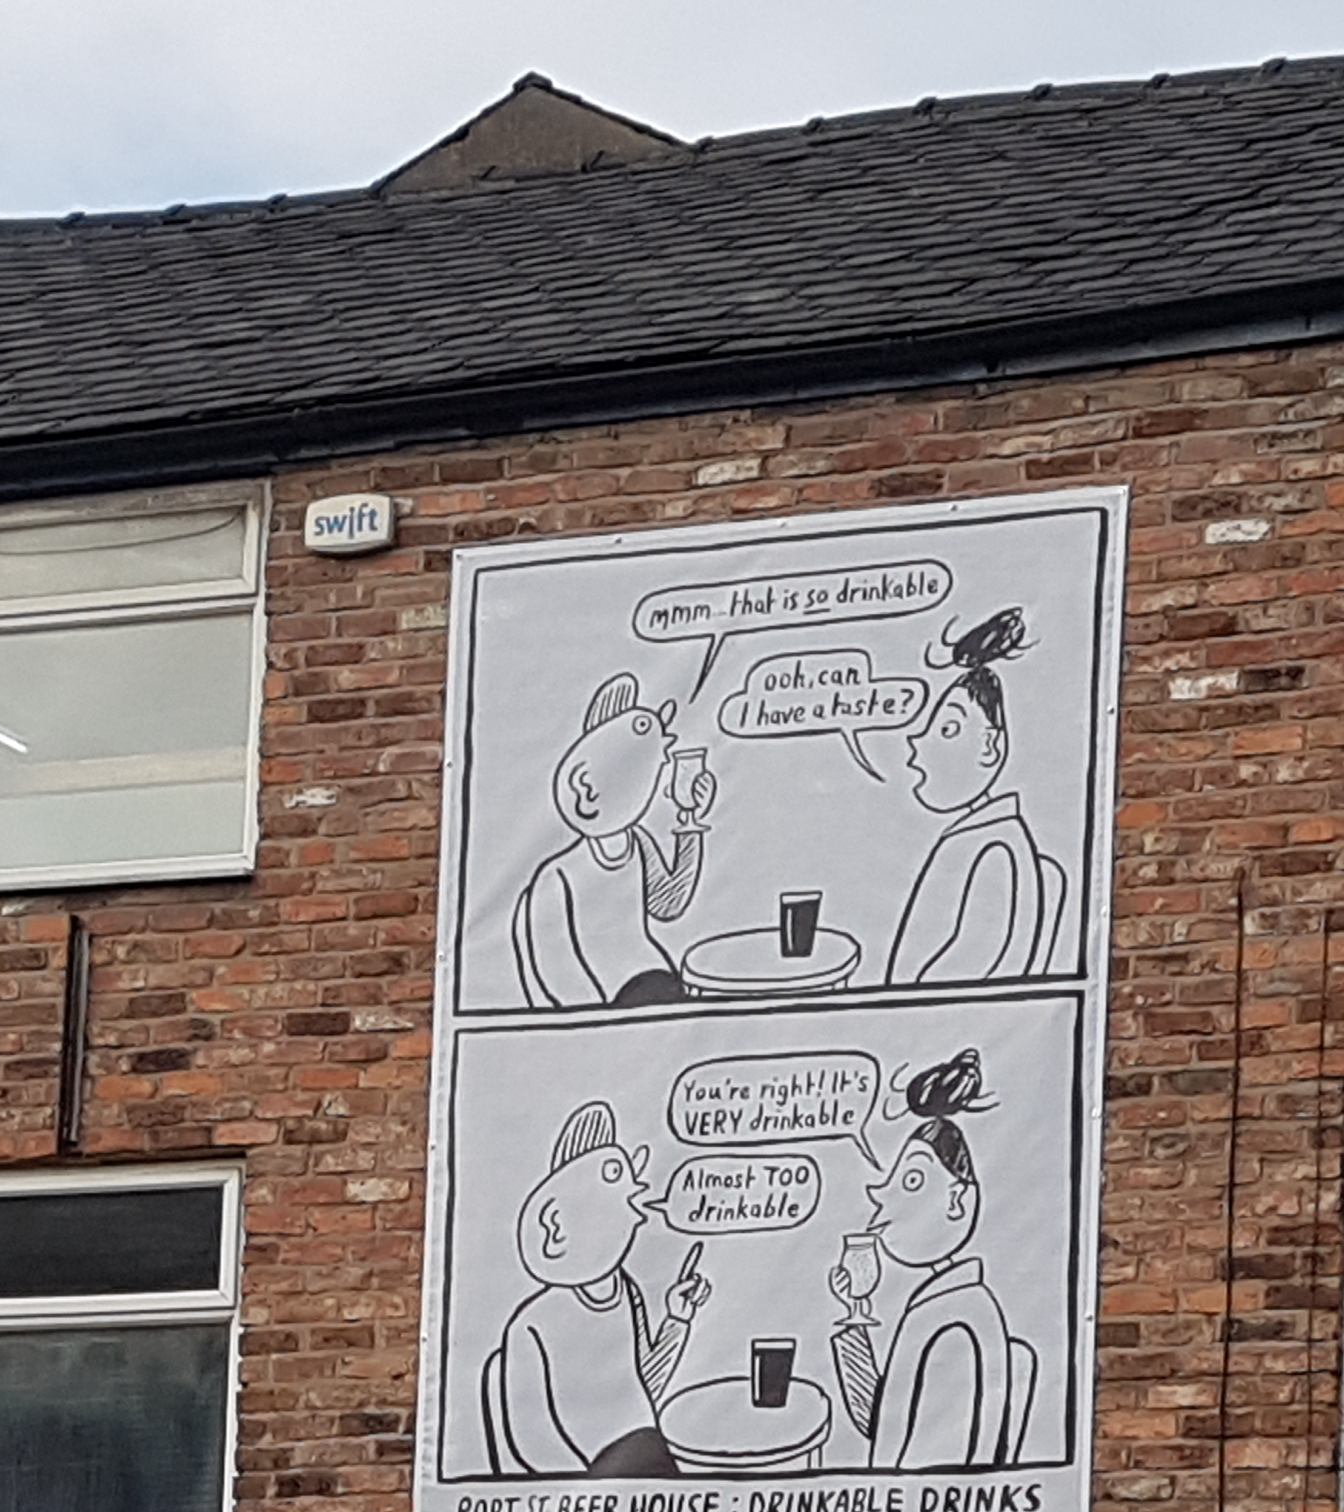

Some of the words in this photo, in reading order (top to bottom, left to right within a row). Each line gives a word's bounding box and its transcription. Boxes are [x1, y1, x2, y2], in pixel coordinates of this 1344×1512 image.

[314, 502, 379, 540] swift
[783, 588, 799, 611] is
[805, 587, 830, 608] so
[836, 571, 939, 604] drinkable
[763, 660, 815, 692] ooh,
[818, 667, 861, 688] can
[756, 700, 807, 726] have
[811, 702, 827, 720] a
[830, 688, 915, 717] taste?
[683, 1078, 751, 1102] You're
[760, 1069, 826, 1107] right!
[831, 1070, 869, 1094] It's
[685, 1108, 744, 1136] VERY
[749, 1098, 856, 1132] drinkable
[682, 1164, 757, 1192] Almost
[762, 1165, 810, 1187] TOO
[688, 1192, 800, 1223] drinkable
